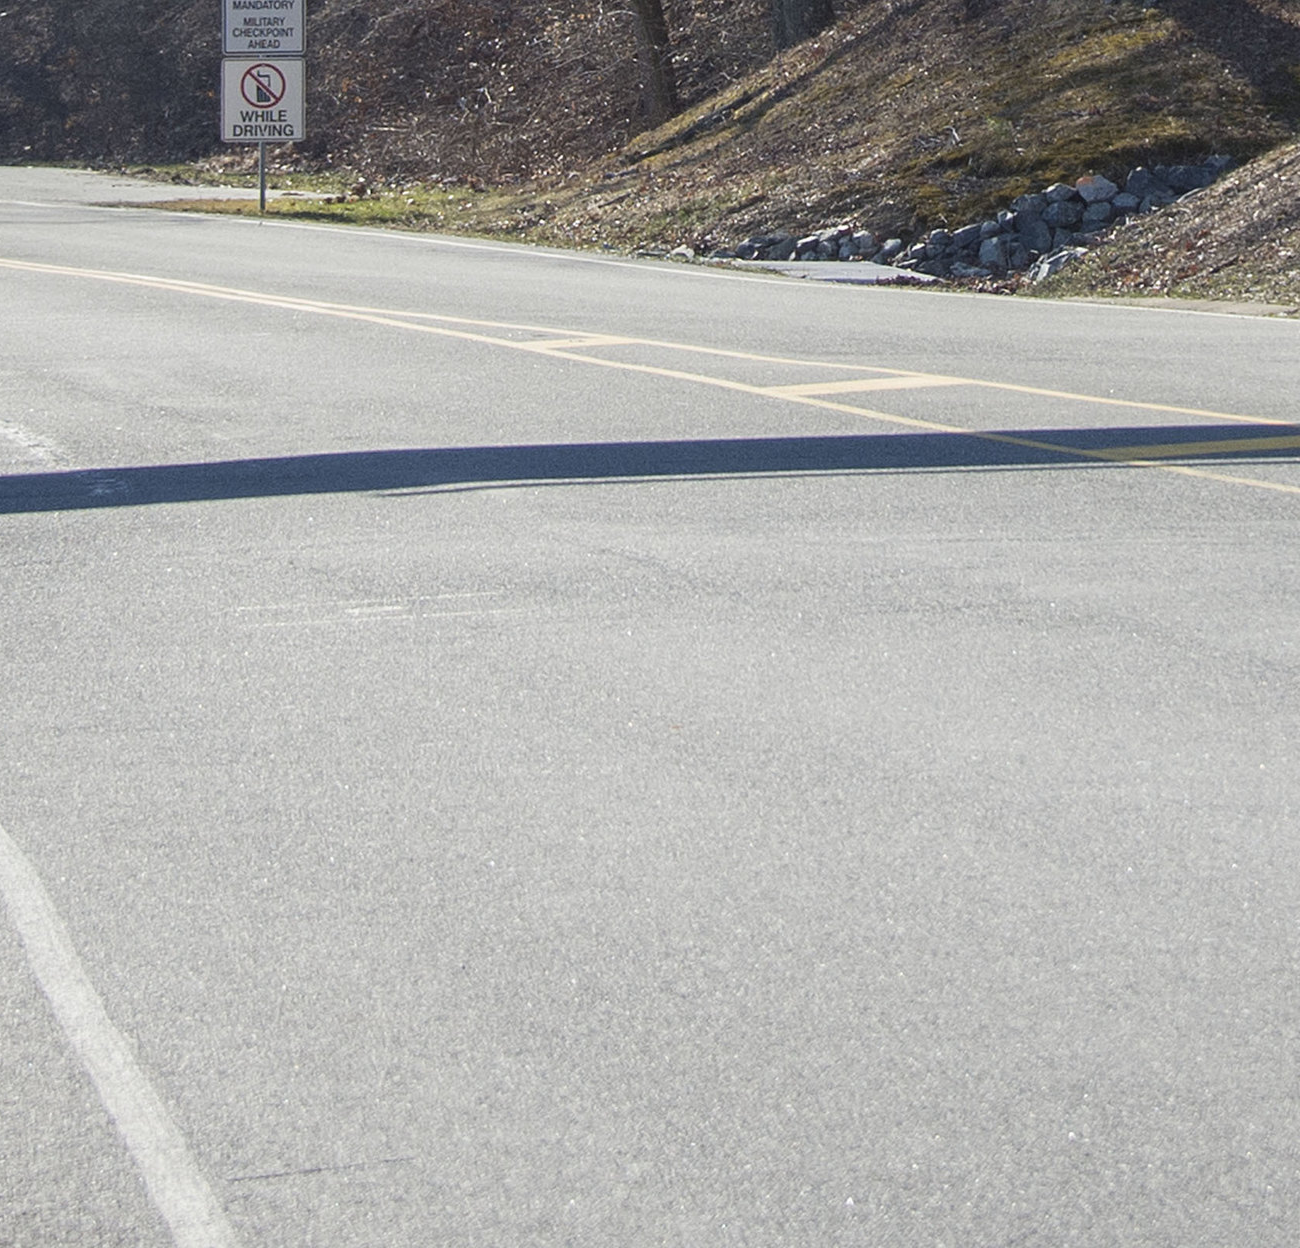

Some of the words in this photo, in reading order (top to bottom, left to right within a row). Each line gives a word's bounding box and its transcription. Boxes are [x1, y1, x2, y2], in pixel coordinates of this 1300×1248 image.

[232, 0, 294, 10] MANDATORY
[243, 16, 286, 26] MILITARY
[232, 27, 294, 38] CHECKPOINT
[247, 39, 281, 50] AHEAD
[240, 110, 288, 123] WHILE
[232, 124, 294, 138] DRIVING
